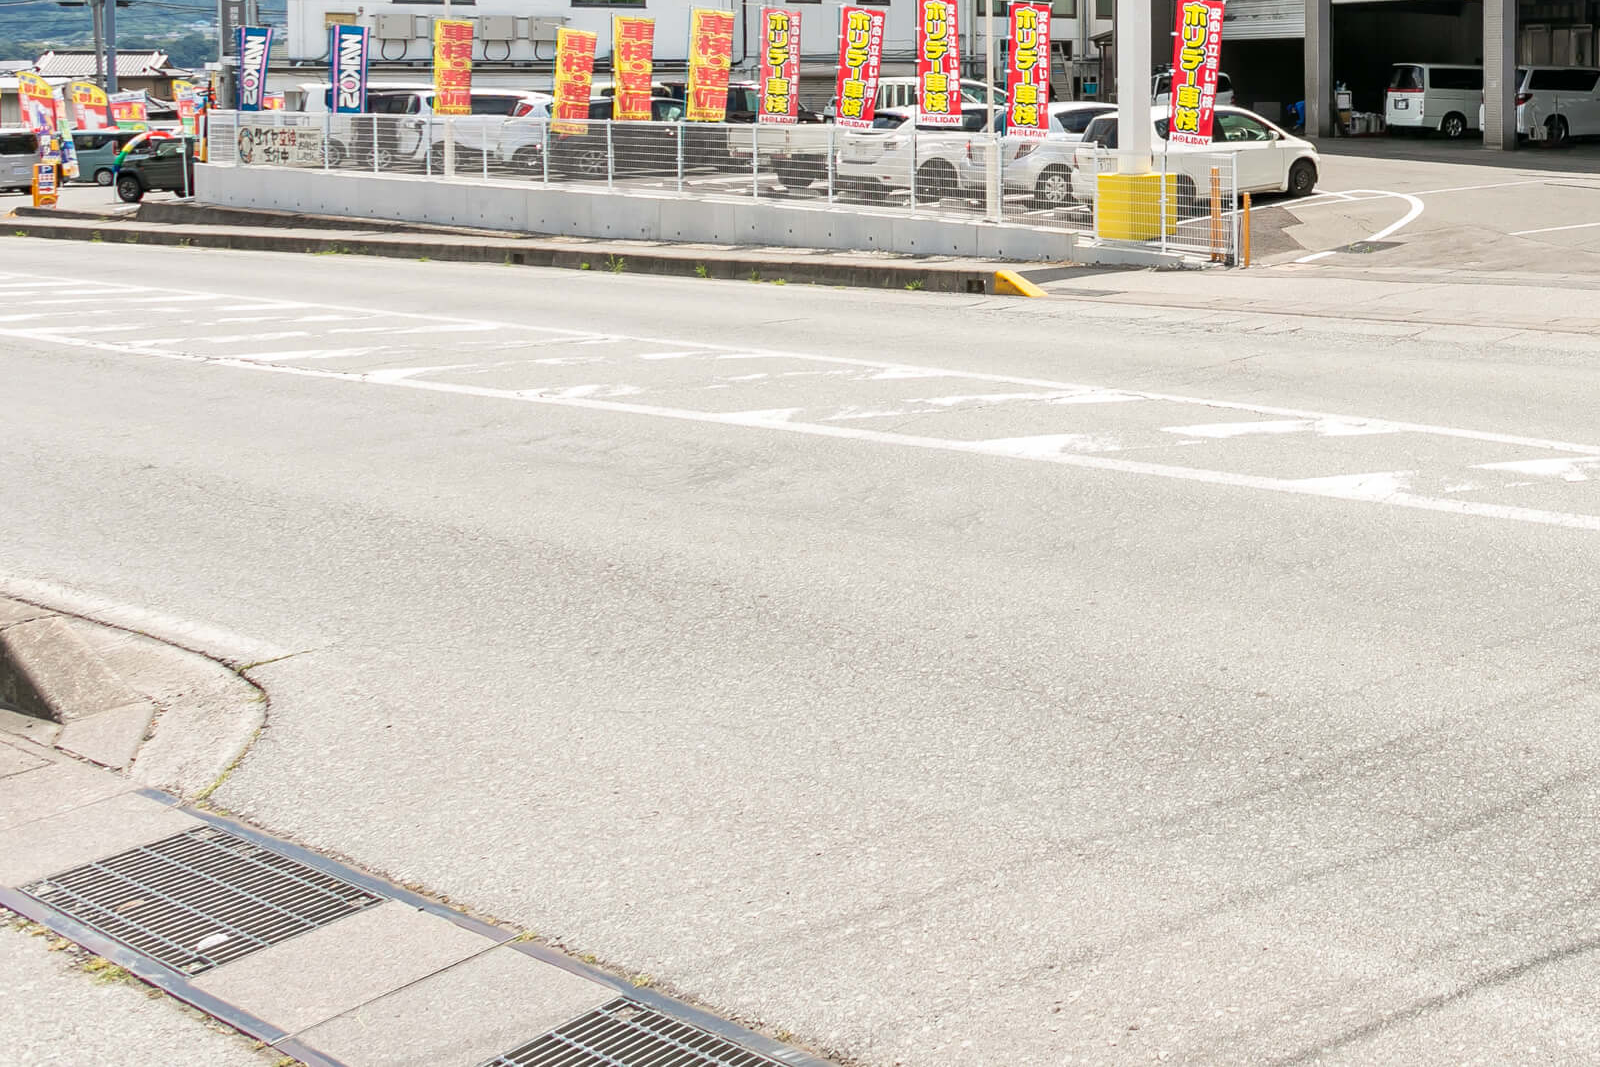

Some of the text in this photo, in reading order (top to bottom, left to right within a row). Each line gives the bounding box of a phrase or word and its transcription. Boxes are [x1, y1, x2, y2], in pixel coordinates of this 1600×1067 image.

[765, 12, 789, 114] ホリデー車検
[841, 11, 871, 118] ホリデー車検
[925, 1, 948, 113] ホリデー車検
[1013, 9, 1038, 126] ホリデー車検
[1175, 3, 1208, 132] ホリデー車検
[760, 116, 798, 124] HOLIDAY
[836, 118, 870, 130] HOLIDAY
[921, 116, 960, 124] HOLIDAY
[1009, 129, 1048, 138] HOLIDAY
[1171, 136, 1209, 146] HOLIDAY
